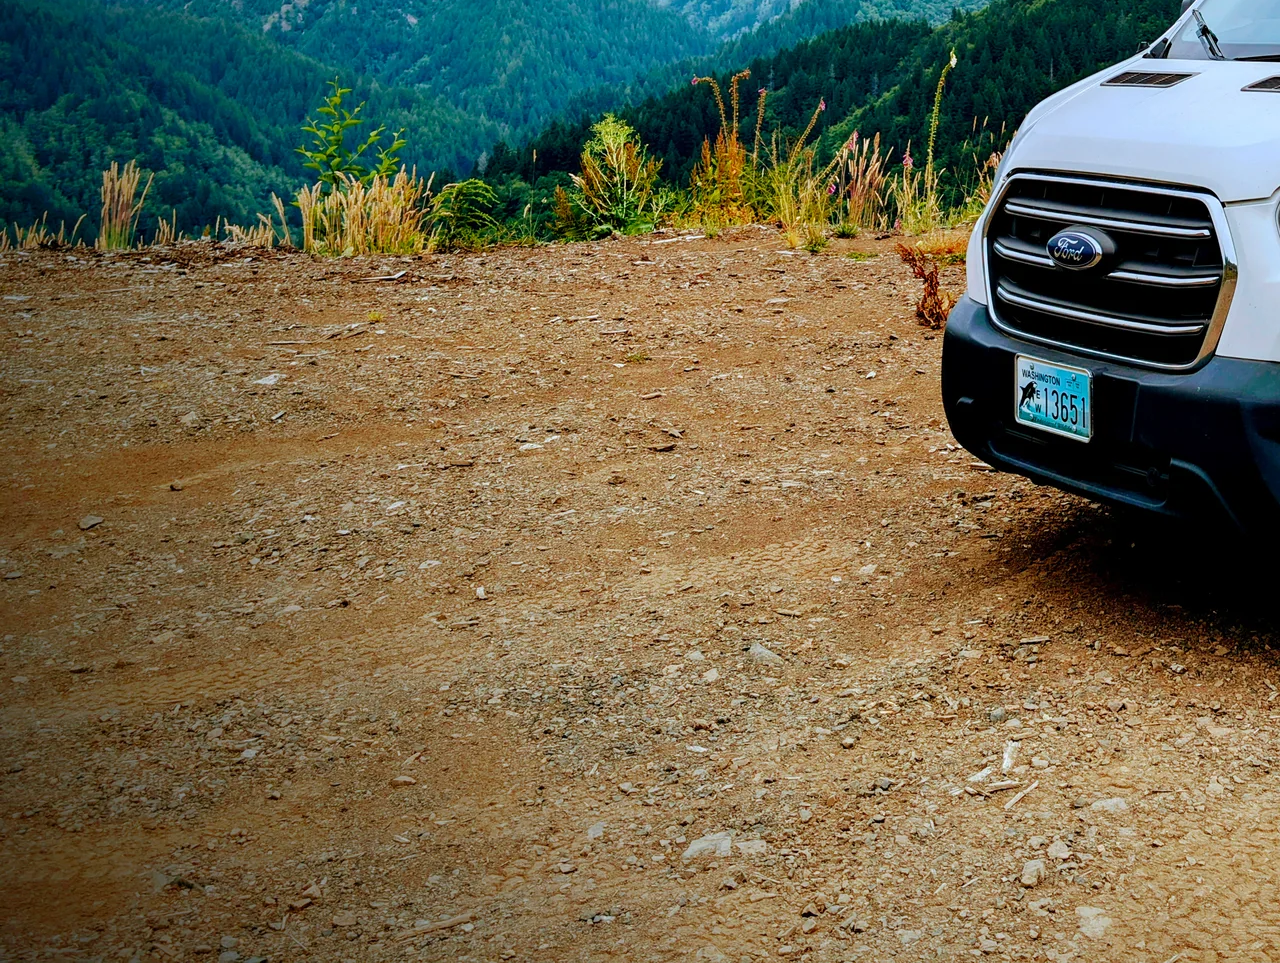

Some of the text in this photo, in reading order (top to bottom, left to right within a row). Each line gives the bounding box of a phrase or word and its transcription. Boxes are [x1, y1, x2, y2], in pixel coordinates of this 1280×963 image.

[1054, 237, 1085, 261] Ford
[1022, 368, 1061, 387] WASHINGTON
[1044, 387, 1086, 428] 13651
